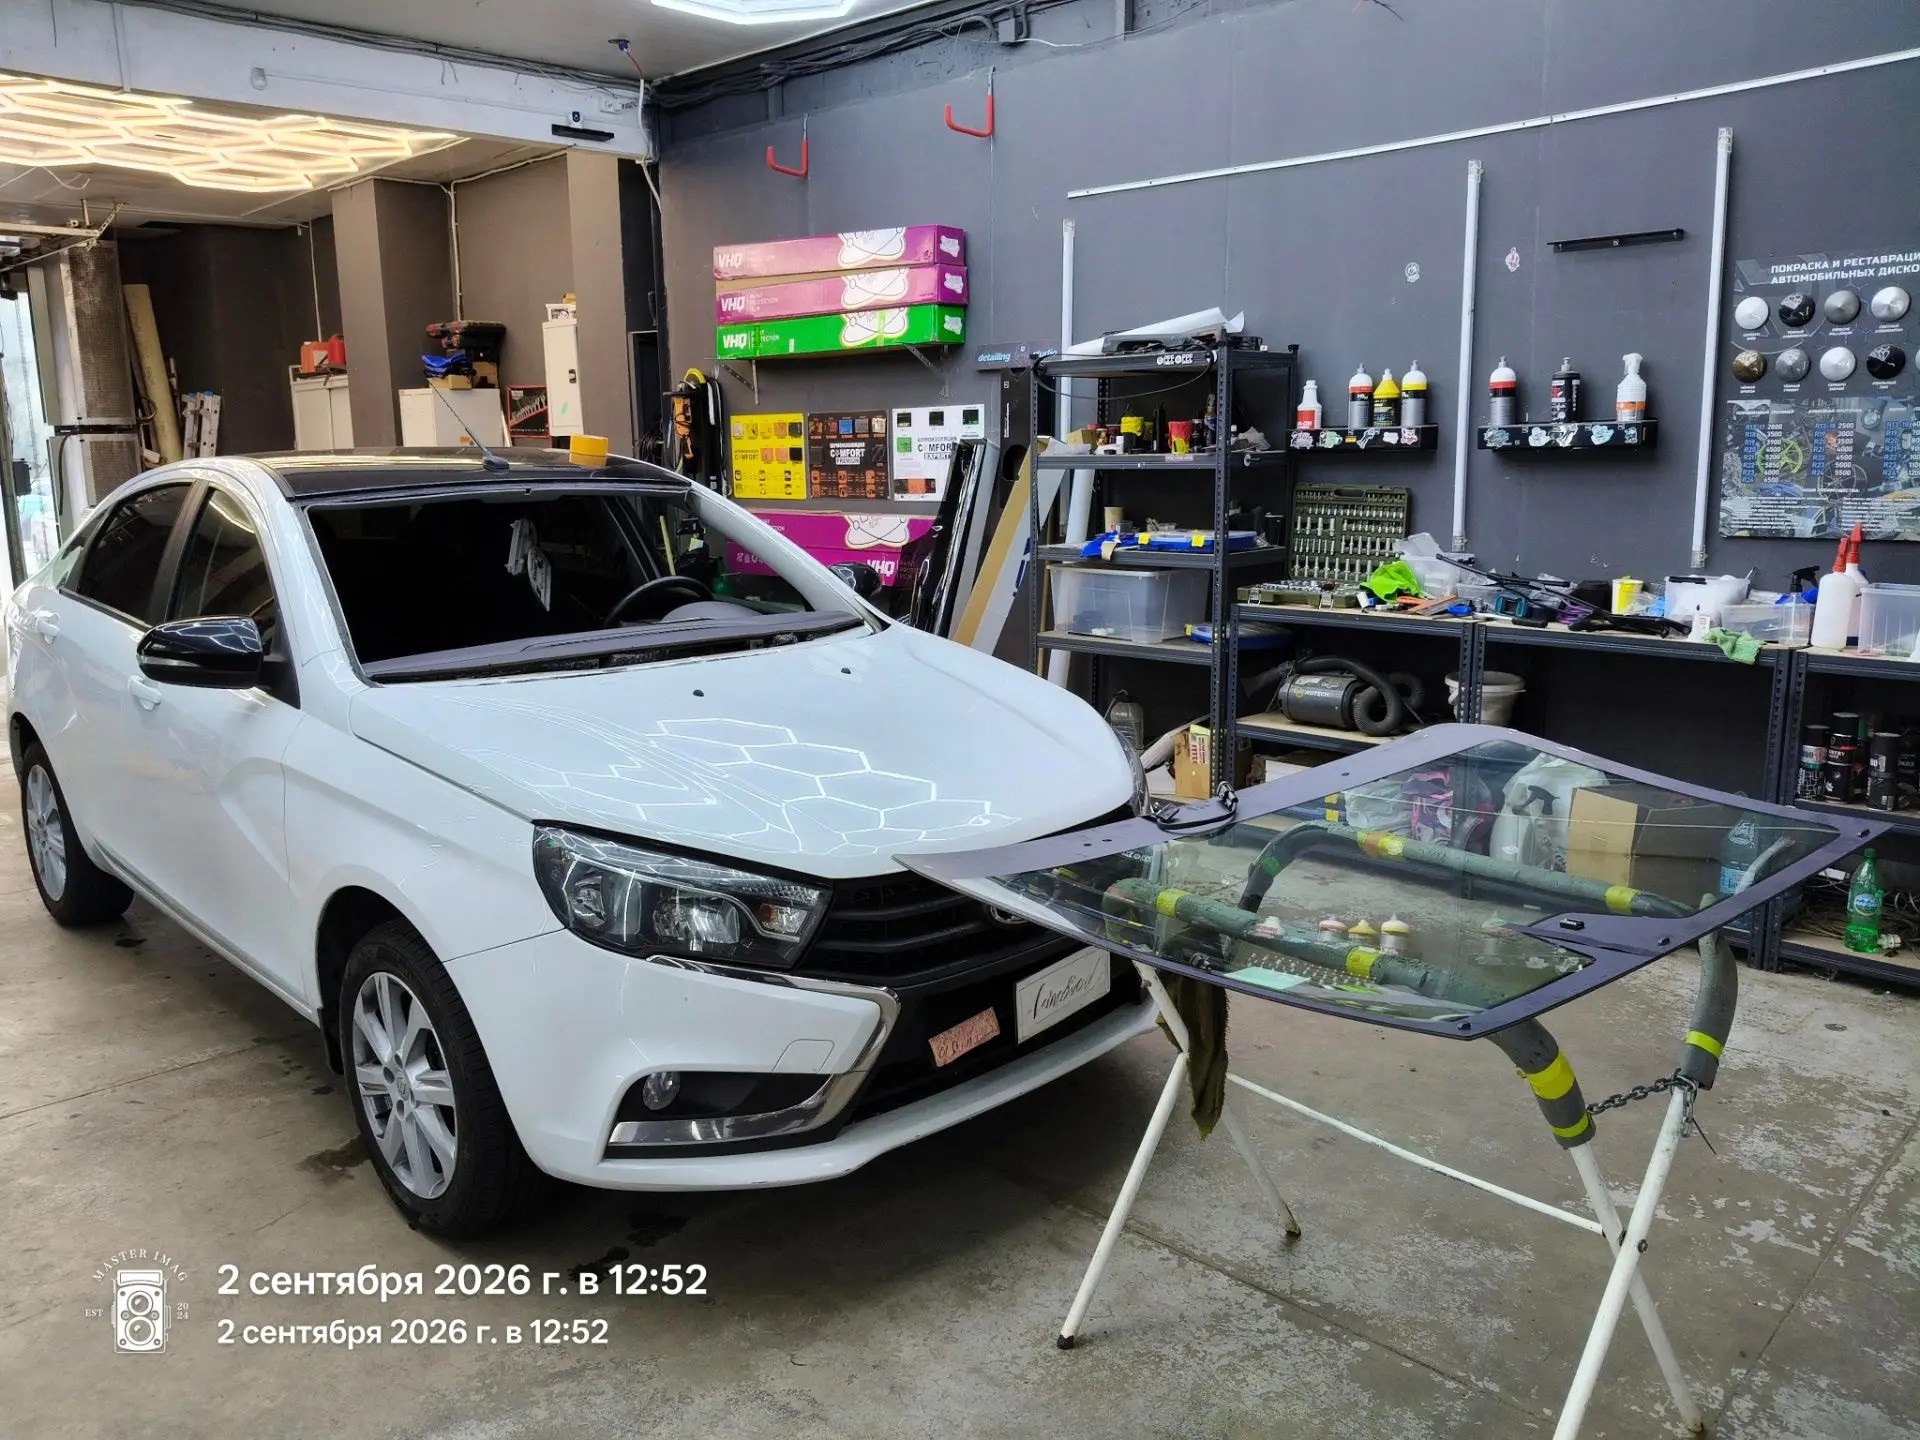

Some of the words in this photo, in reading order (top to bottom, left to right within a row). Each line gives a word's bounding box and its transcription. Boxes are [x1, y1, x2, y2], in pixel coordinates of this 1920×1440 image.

[719, 253, 743, 268] VHQ
[1770, 261, 1829, 273] ПОКРАСКА
[1832, 260, 1840, 268] И
[1770, 268, 1875, 284] АВТОМОБИЛЬНЫХ
[721, 296, 745, 312] VHQ
[722, 333, 748, 349] VHQ
[978, 352, 1012, 363] detailing
[917, 442, 956, 453] COMFOR
[867, 559, 896, 577] VHQ
